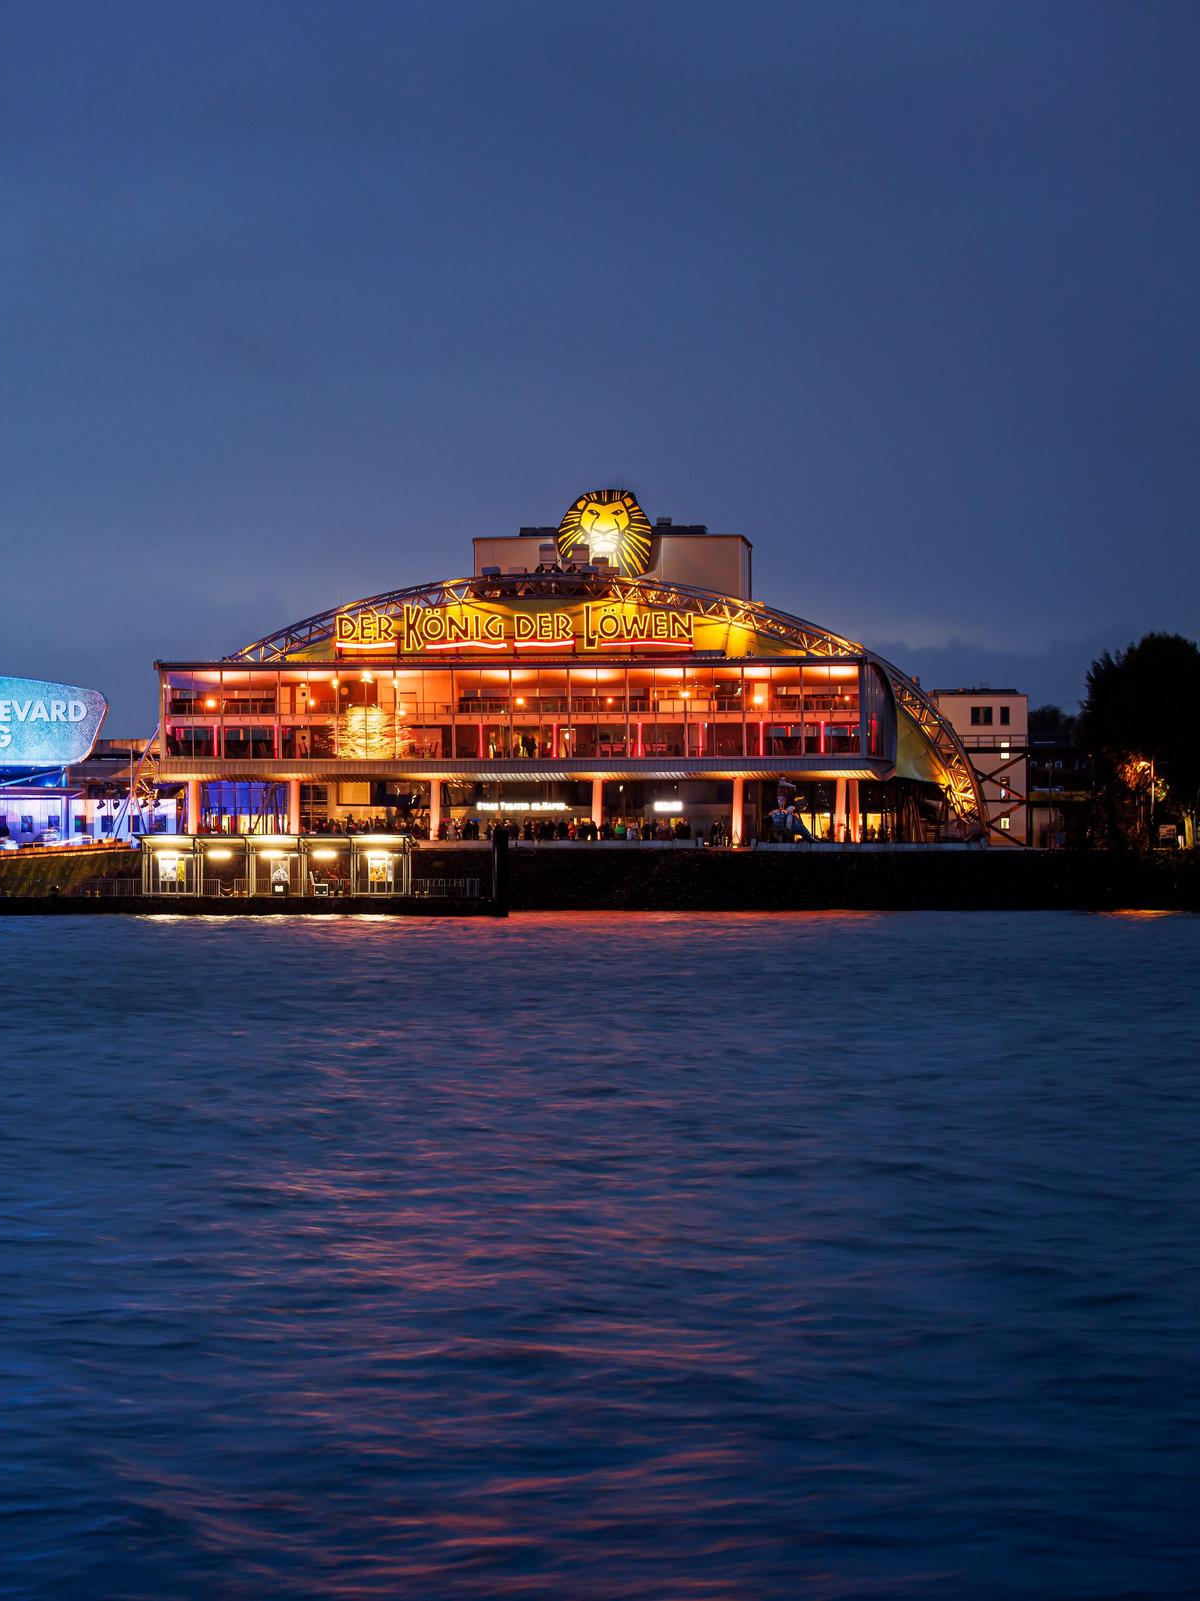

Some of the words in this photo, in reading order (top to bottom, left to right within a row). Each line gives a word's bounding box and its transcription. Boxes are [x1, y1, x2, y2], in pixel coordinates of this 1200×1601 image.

[336, 614, 394, 641] DER
[404, 604, 504, 650] KÖNIG
[514, 613, 574, 640] DER
[584, 603, 694, 650] LÖWEN
